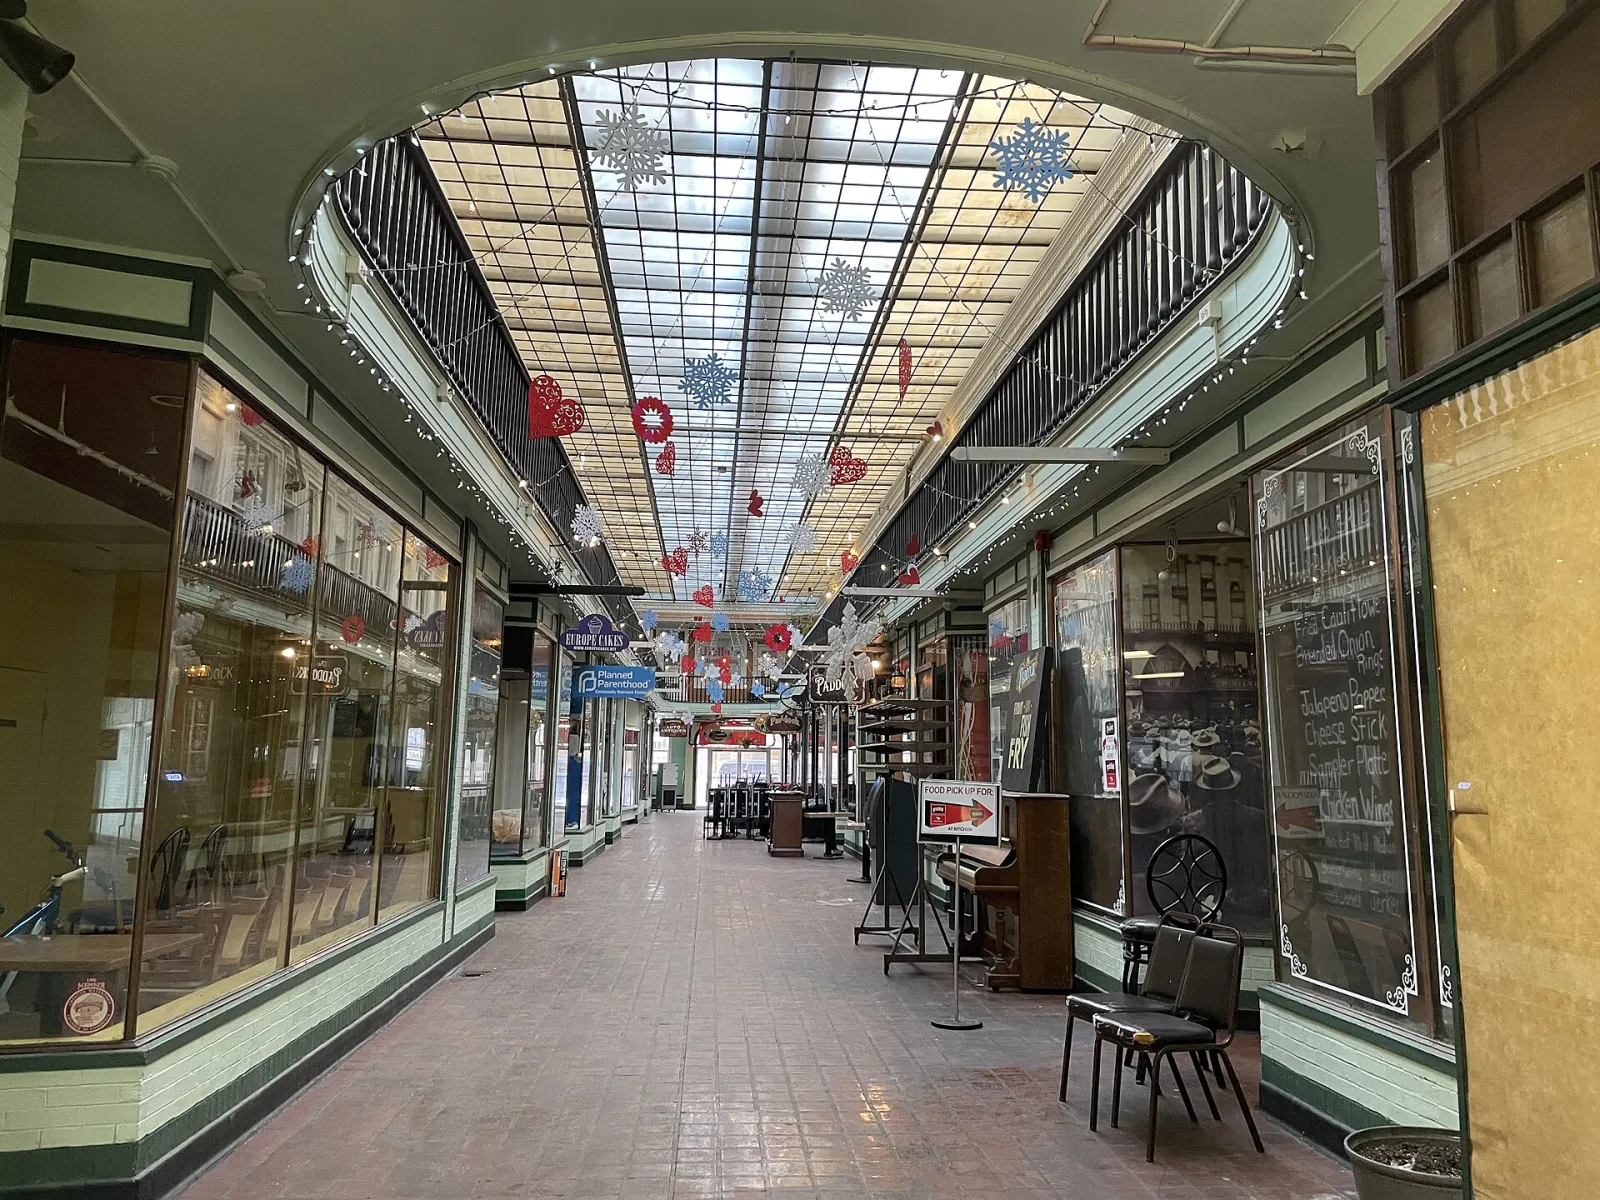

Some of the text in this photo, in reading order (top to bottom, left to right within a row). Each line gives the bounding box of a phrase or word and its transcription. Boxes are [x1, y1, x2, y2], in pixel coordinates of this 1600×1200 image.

[565, 633, 624, 647] EUROPE CAKES
[1338, 629, 1375, 660] Onion
[598, 671, 633, 679] Planned
[598, 680, 648, 689] Parenthood
[1299, 687, 1349, 719] Jalapeno
[1305, 719, 1347, 748] Cheese
[1008, 737, 1029, 770] FRY
[1309, 747, 1354, 777] Sampler
[925, 786, 945, 794] FOOD
[1320, 785, 1394, 836] Chicken Wings
[77, 982, 106, 990] MEMBER
